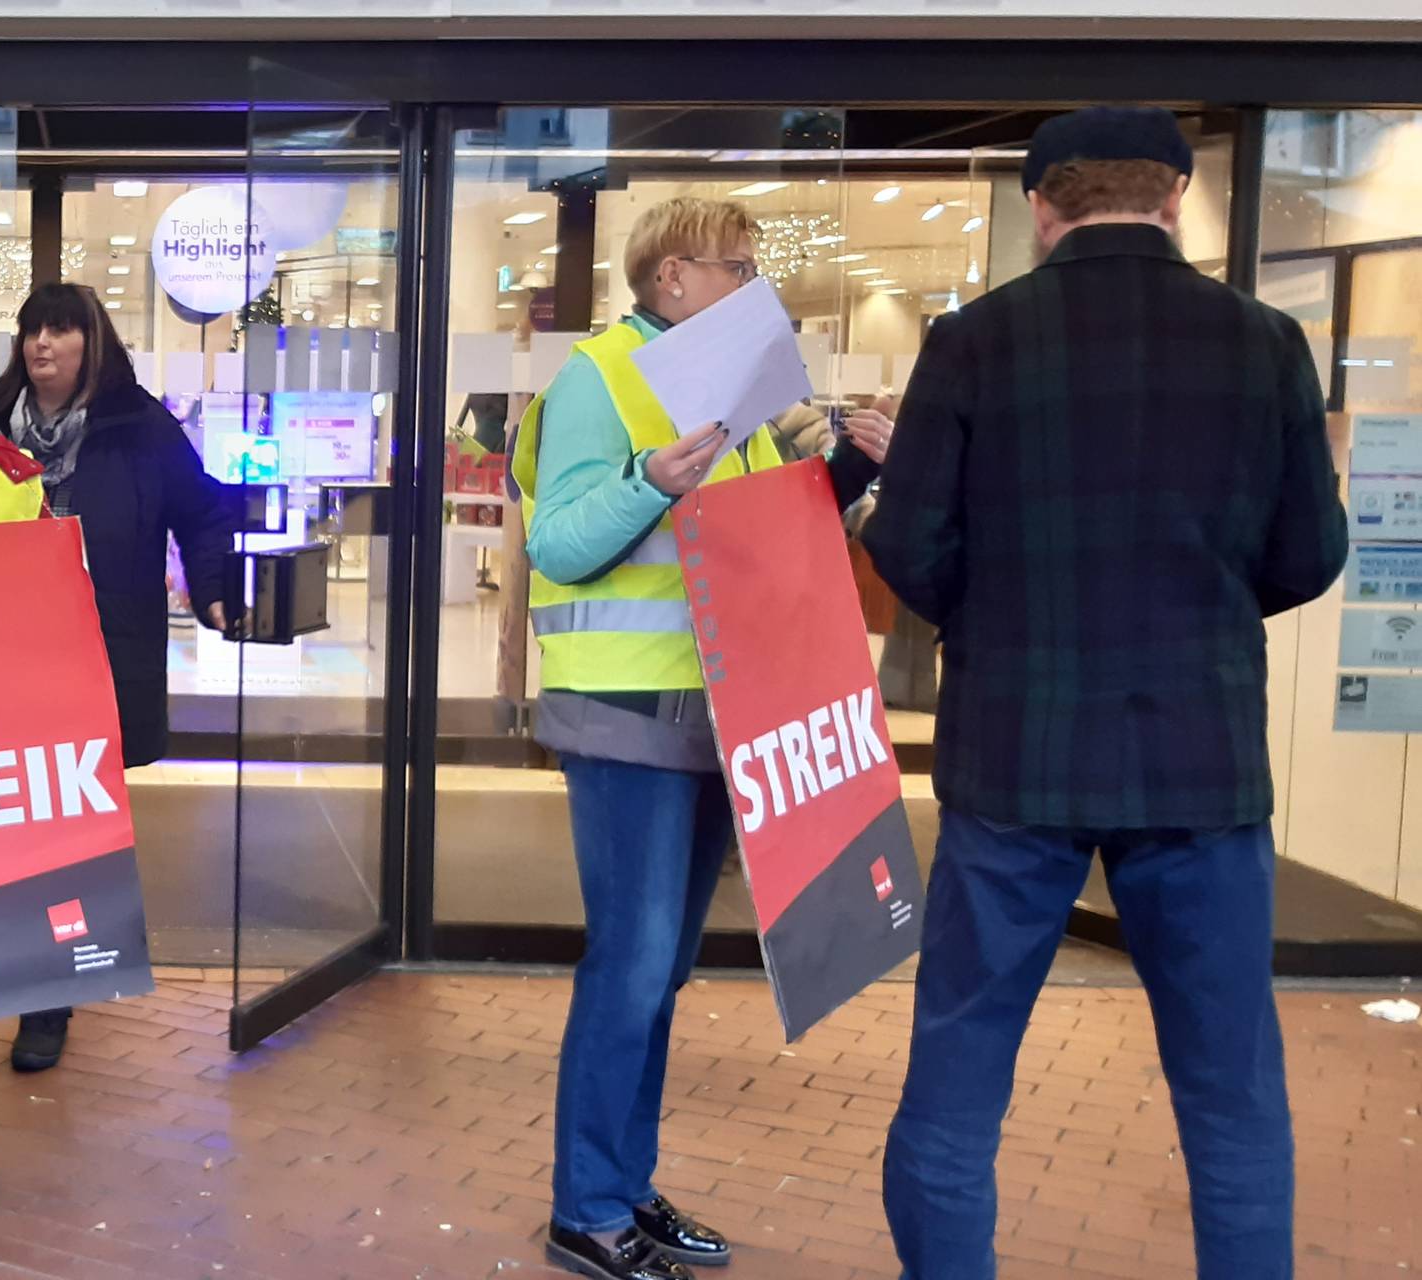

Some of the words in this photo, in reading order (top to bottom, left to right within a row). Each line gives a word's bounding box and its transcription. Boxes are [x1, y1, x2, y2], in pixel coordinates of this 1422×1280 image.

[171, 217, 228, 240] Täglich
[163, 238, 267, 261] Highlight
[169, 272, 212, 282] unserem
[216, 269, 262, 284] Prospkt
[731, 687, 888, 833] STREIK
